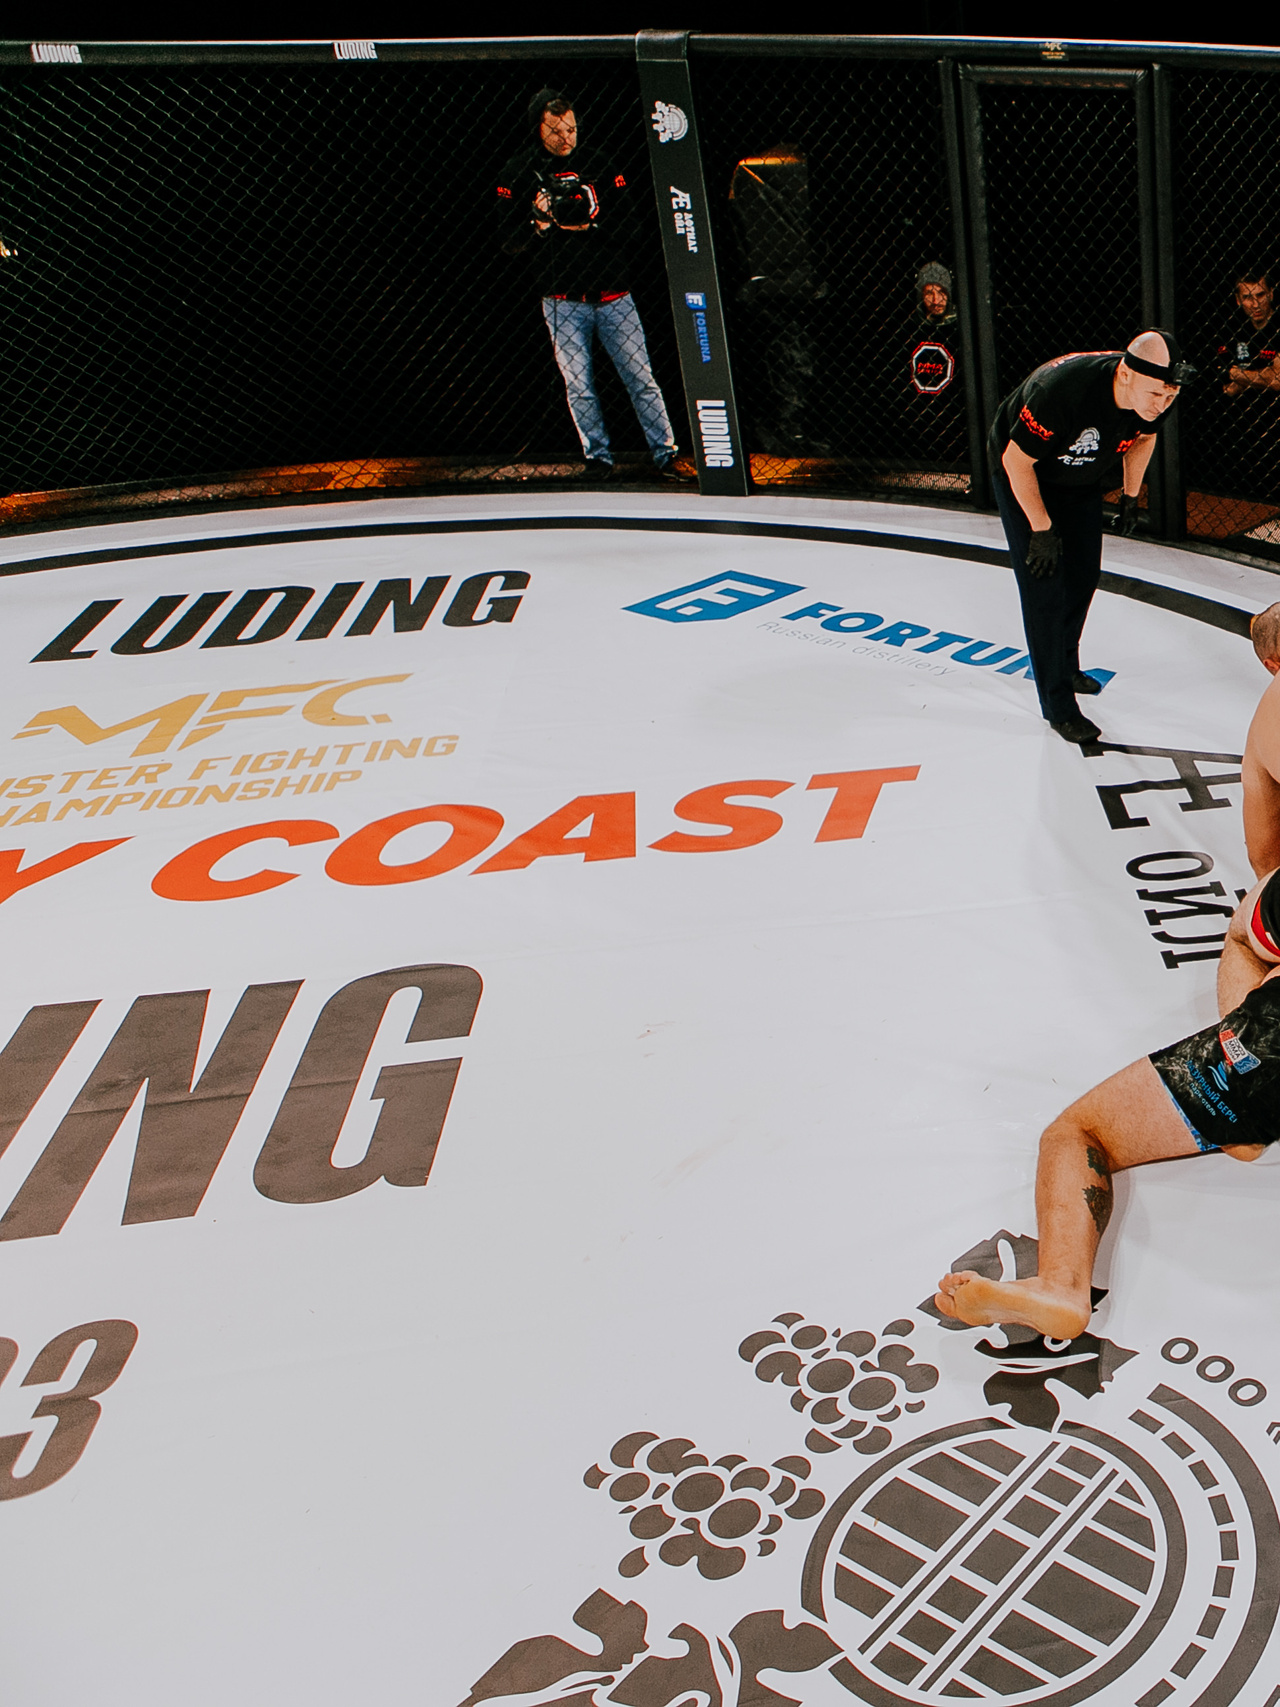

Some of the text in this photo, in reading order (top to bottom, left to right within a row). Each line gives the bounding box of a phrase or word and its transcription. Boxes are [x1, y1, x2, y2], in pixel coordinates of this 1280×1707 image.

[31, 43, 82, 63] LUDING
[334, 41, 378, 60] LUDING
[696, 312, 712, 364] FORTUNA
[696, 400, 734, 468] LUDING
[29, 569, 532, 664] LUDING
[780, 600, 1117, 696] FORTU
[756, 620, 958, 679] Russian distillery
[188, 735, 460, 780] FIGHTING
[151, 764, 922, 902] COAST
[0, 1319, 139, 1501] 3
